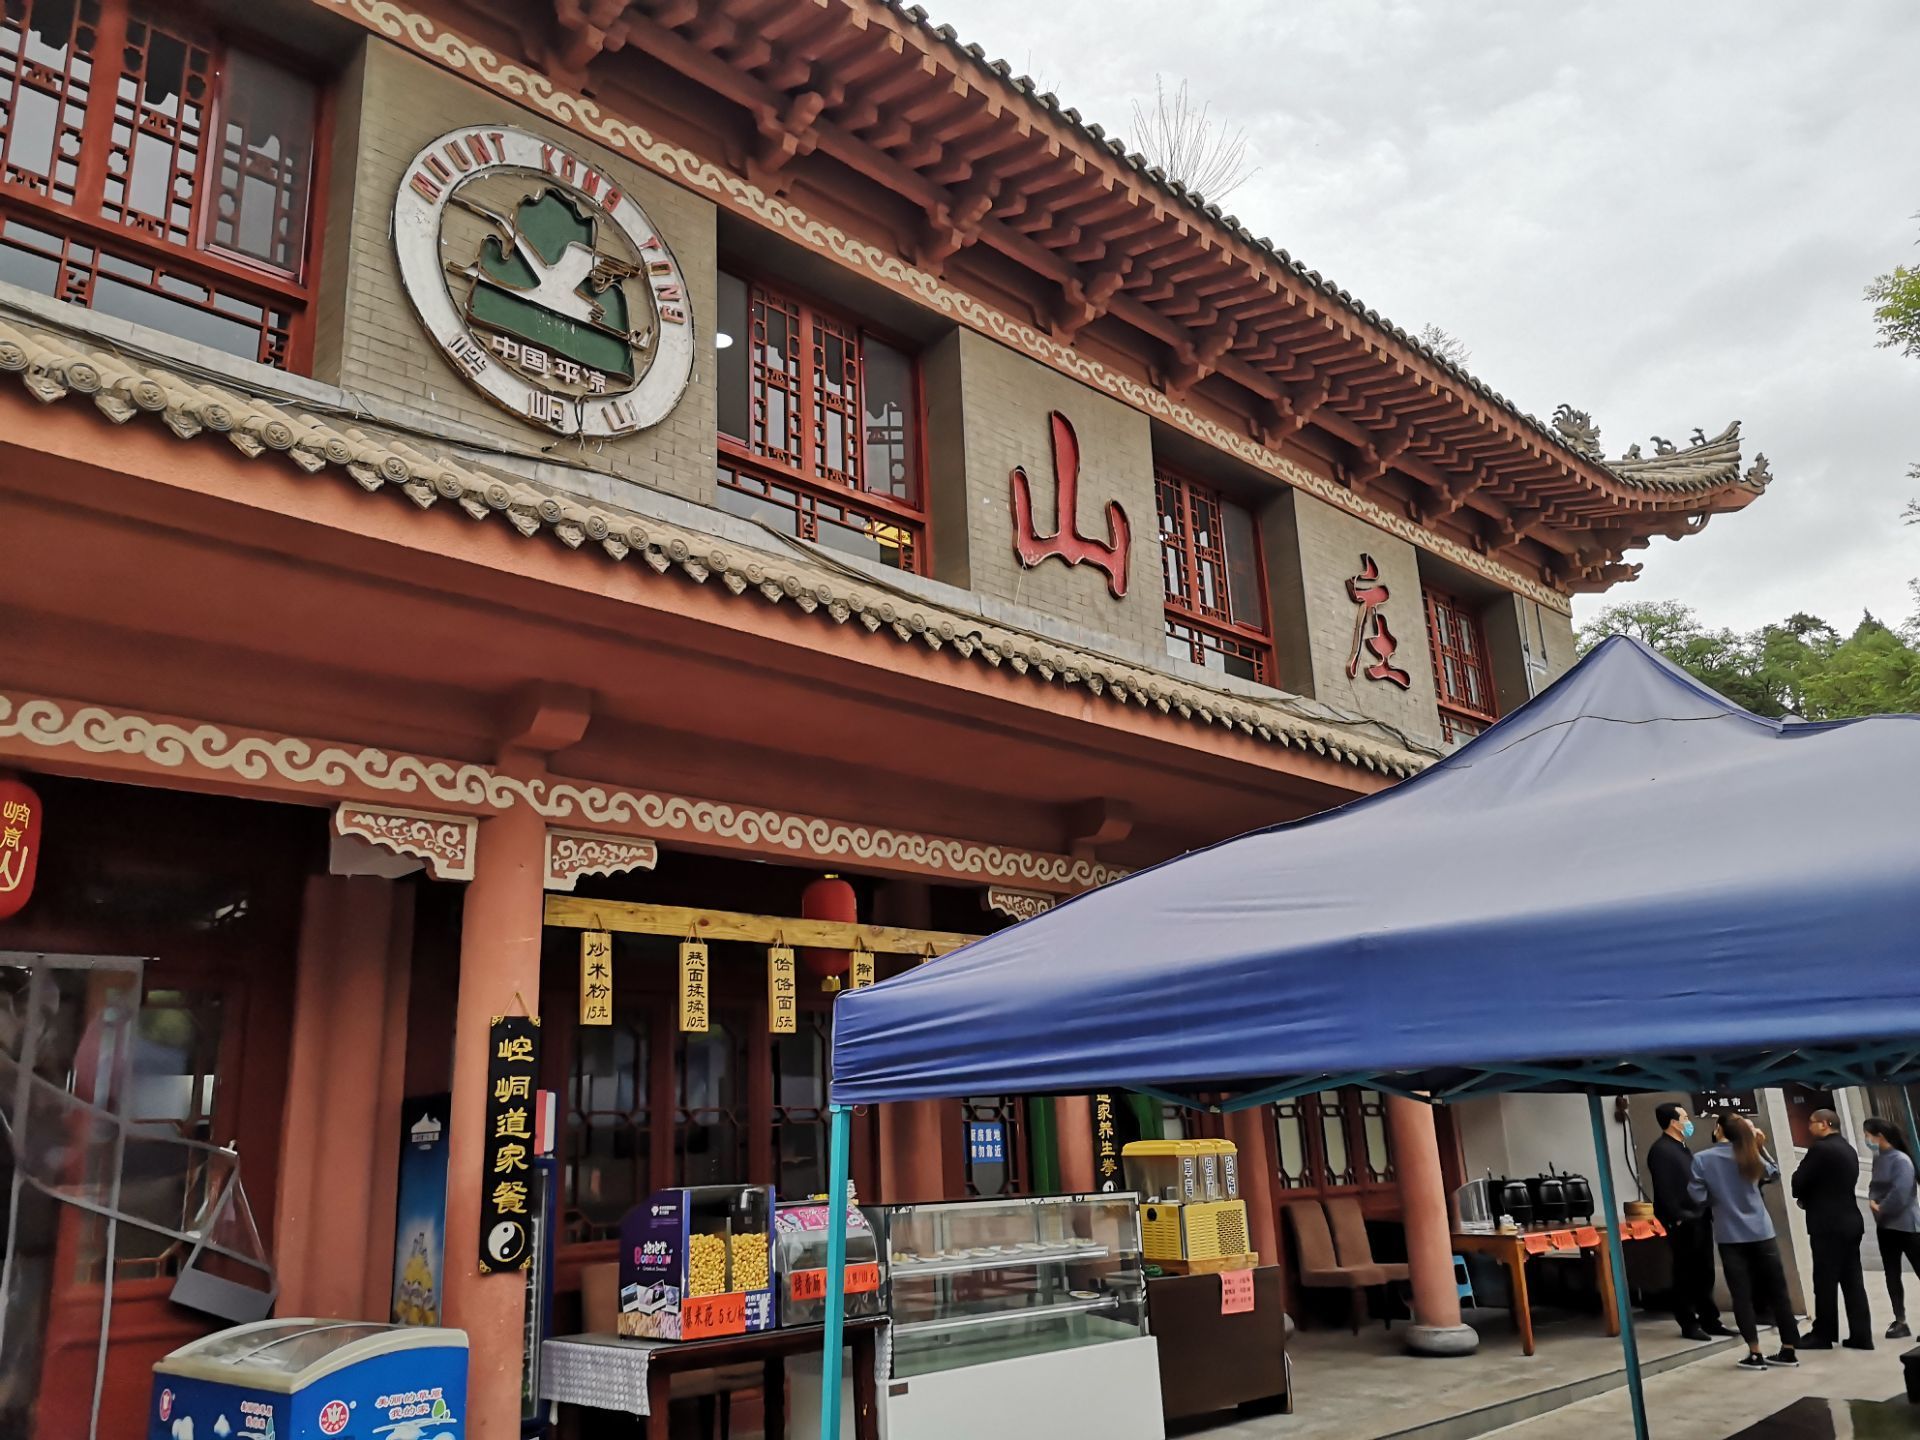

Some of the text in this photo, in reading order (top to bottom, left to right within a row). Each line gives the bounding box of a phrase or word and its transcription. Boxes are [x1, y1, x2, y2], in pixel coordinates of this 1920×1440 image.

[409, 132, 685, 325] MOUNT KONG TONG
[492, 335, 607, 393] 中国平凉
[1009, 409, 1131, 600] 山
[585, 942, 610, 999] 炒米粉
[774, 957, 794, 1010] 饸饹面
[586, 1006, 609, 1019] 15元
[686, 1016, 706, 1028] 10元
[775, 1016, 793, 1028] 15元
[492, 1035, 536, 1215] 崆峒道家餐
[1707, 1097, 1741, 1108] 小超市
[683, 1304, 713, 1329] 爆米花
